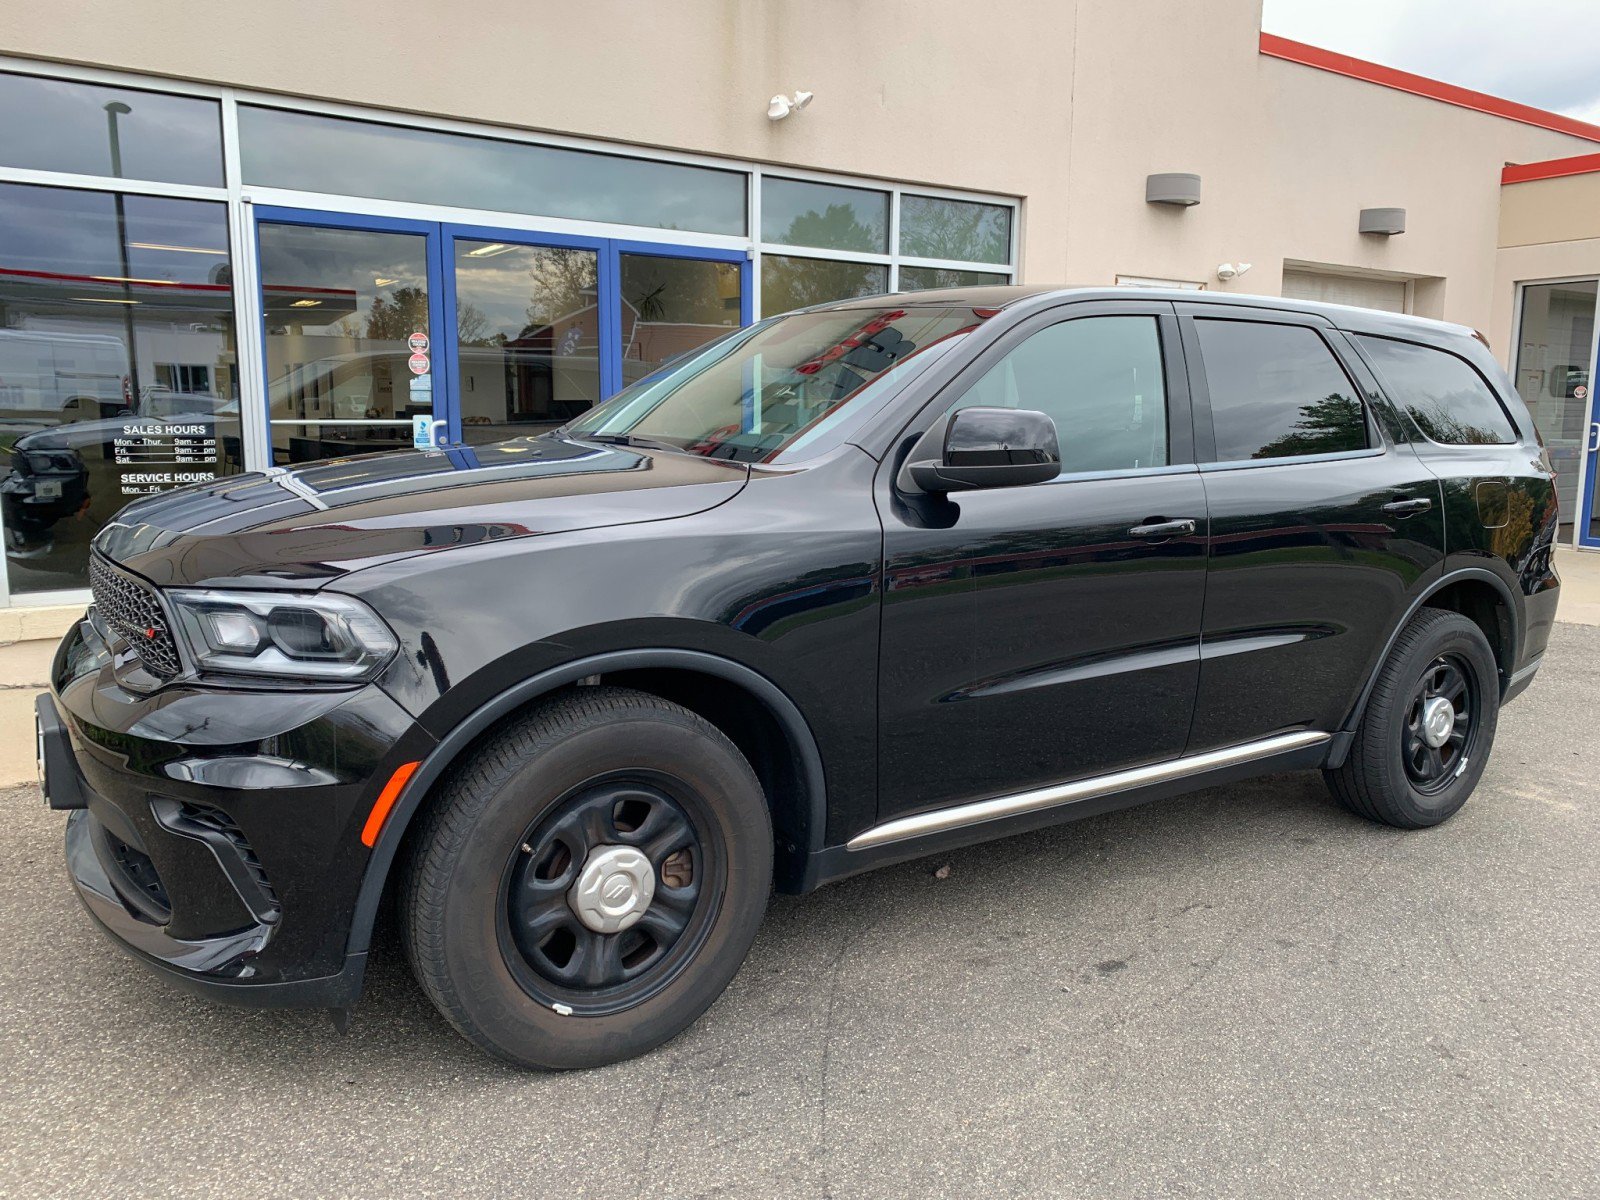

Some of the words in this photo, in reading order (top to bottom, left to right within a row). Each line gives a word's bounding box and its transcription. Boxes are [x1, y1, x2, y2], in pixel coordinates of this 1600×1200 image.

[123, 425, 162, 434] SALES
[165, 425, 206, 434] HOURS
[114, 438, 135, 446] Mon.
[174, 438, 192, 446] 9am
[115, 455, 132, 464] Sat.
[175, 455, 193, 463] 9am
[121, 473, 171, 483] SERVICE
[174, 472, 215, 482] HOURS
[121, 486, 142, 494] Mon.
